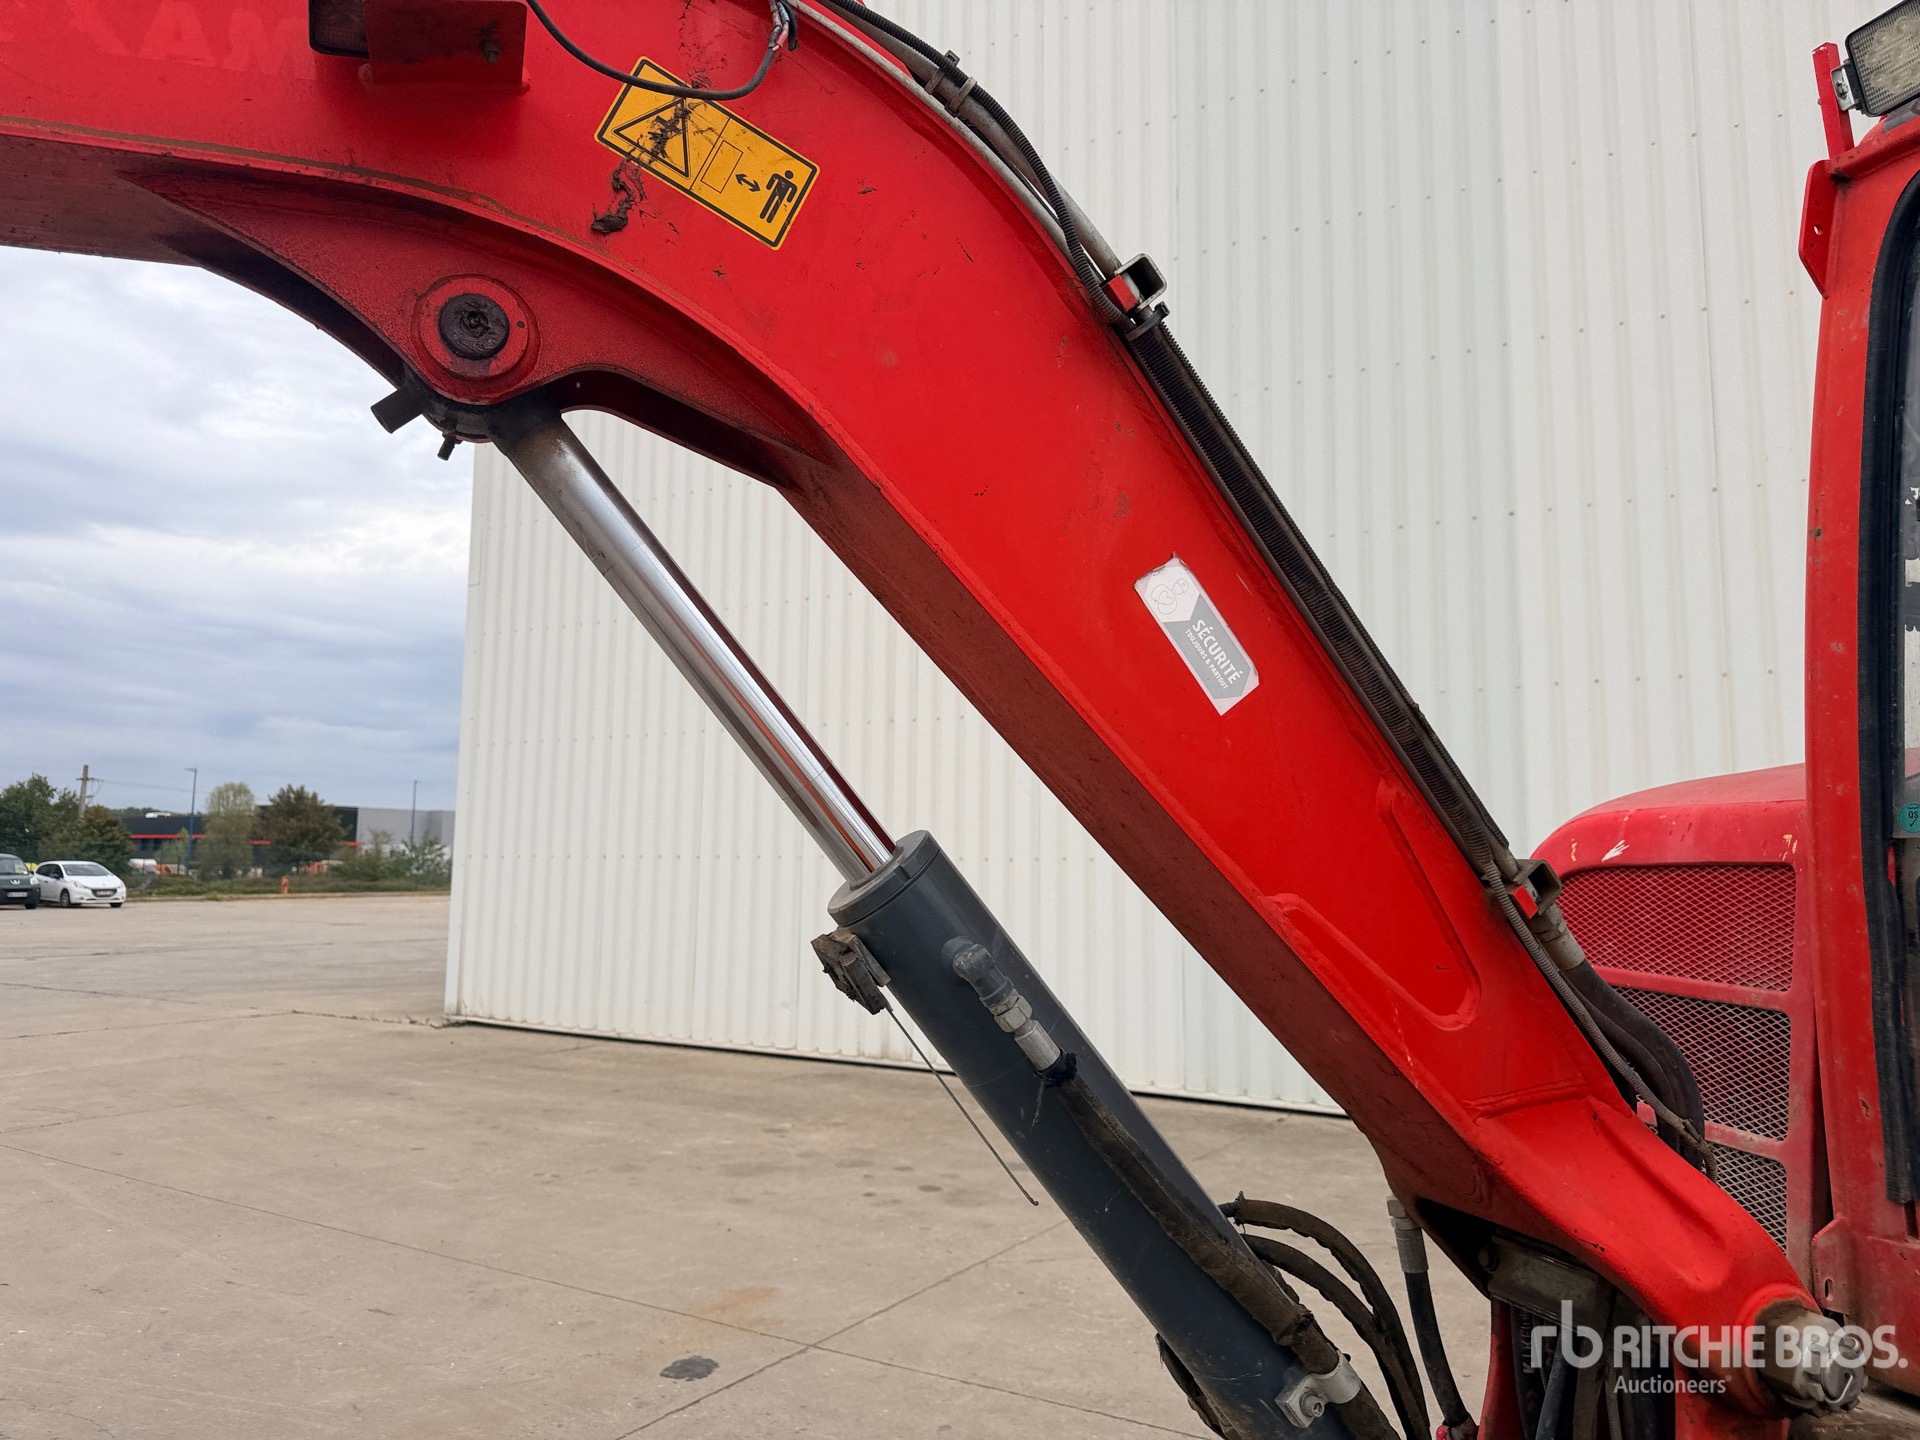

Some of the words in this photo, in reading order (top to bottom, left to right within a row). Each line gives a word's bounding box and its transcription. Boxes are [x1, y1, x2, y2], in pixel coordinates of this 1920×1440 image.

[1185, 628, 1208, 660] TOUJOURS
[1209, 664, 1228, 690] PARTOUT
[1192, 619, 1243, 685] SÉCURITÉ
